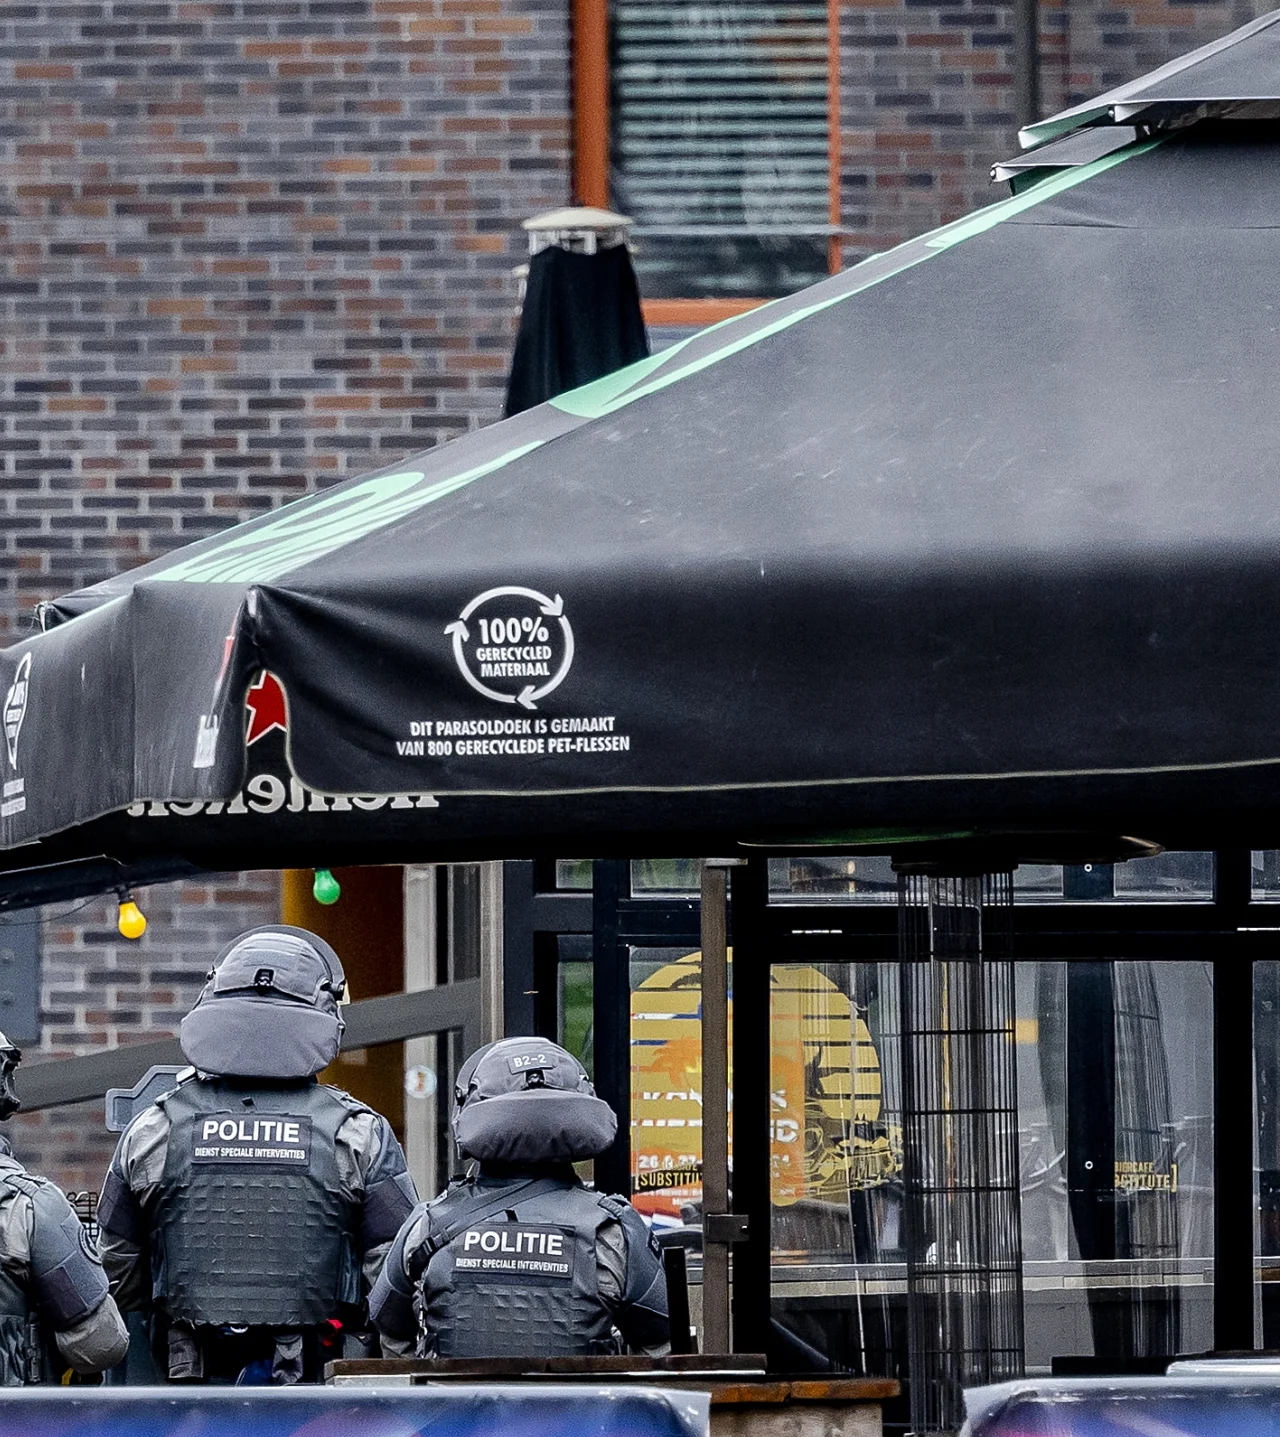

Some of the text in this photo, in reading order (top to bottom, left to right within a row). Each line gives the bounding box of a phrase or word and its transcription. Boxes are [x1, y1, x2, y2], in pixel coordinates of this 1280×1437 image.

[478, 616, 549, 644] 100%
[476, 646, 552, 661] GERECYCLED
[481, 662, 550, 677] MATERIAAL
[410, 717, 616, 736] DIT PARASOLDOEK IS GEMAAKT
[396, 736, 630, 756] VAN 800 GERECYCLEDE PET-FLESSEN
[513, 1053, 547, 1068] B2-2
[202, 1119, 300, 1143] POLITIE
[194, 1147, 306, 1160] DIENST SPECIALE INTERVENTIES
[640, 1171, 699, 1188] SUBSTITU
[463, 1230, 564, 1256] POLITIE
[455, 1257, 569, 1273] DIENST SPECIALE INTERVENTIES
